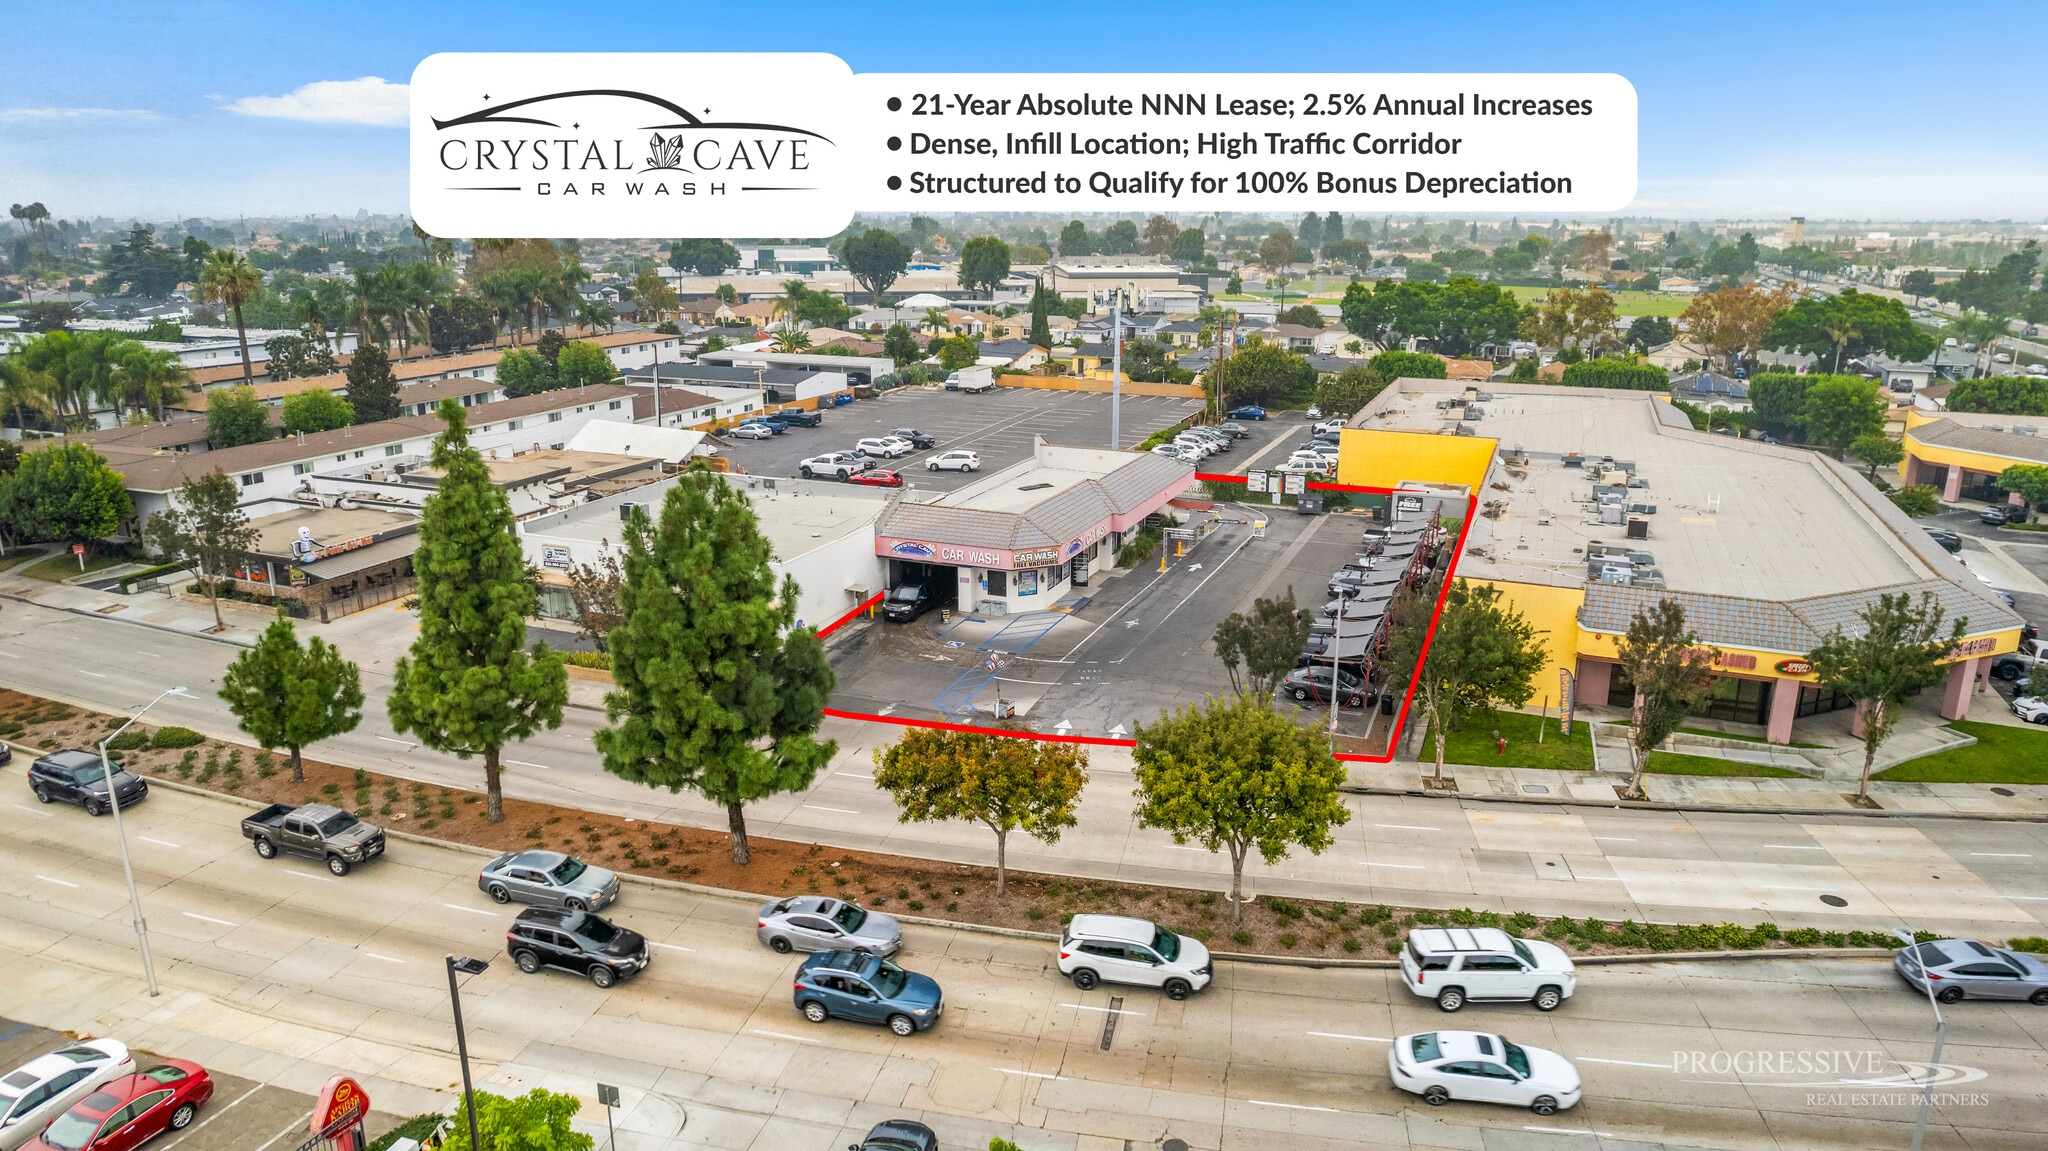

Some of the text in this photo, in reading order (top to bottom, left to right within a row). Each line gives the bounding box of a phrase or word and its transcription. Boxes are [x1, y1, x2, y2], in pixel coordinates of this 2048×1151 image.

[941, 547, 1001, 566] CAR WASH
[1013, 552, 1033, 564] CAR
[1034, 550, 1059, 561] WASH
[1713, 651, 1758, 671] CASHED
